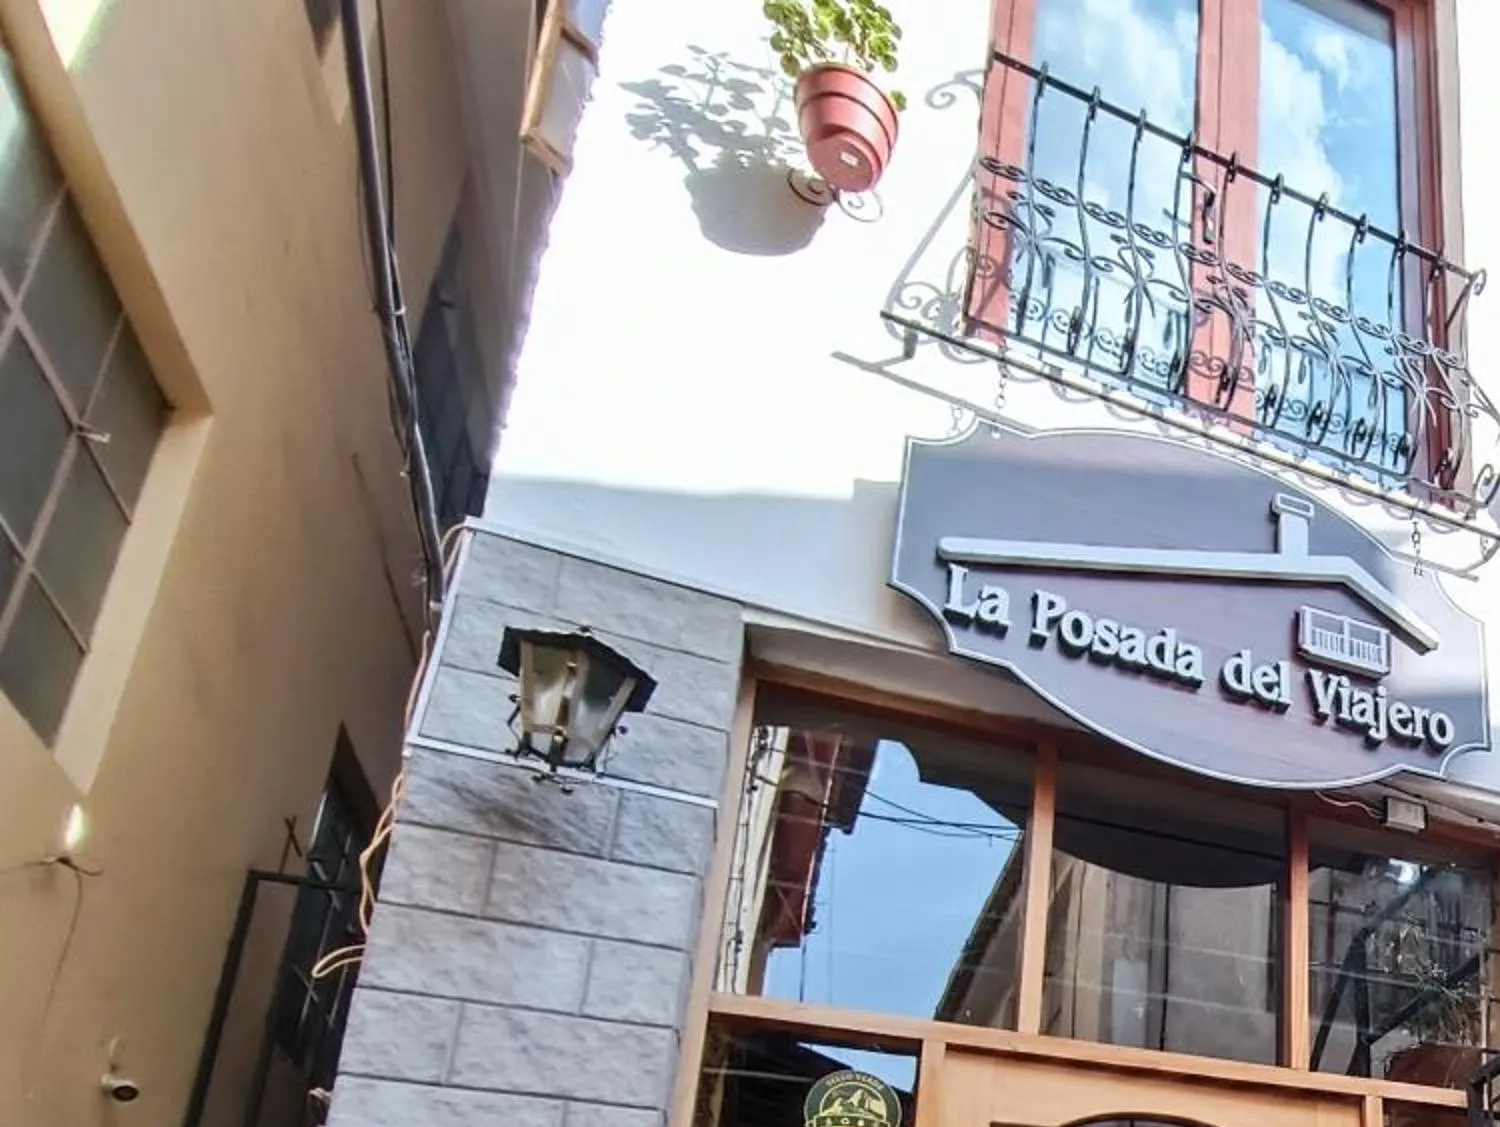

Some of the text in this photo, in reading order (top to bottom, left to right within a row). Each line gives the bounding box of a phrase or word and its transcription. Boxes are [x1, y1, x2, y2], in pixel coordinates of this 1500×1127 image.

[944, 563, 1455, 745] La Posada del Viajero
